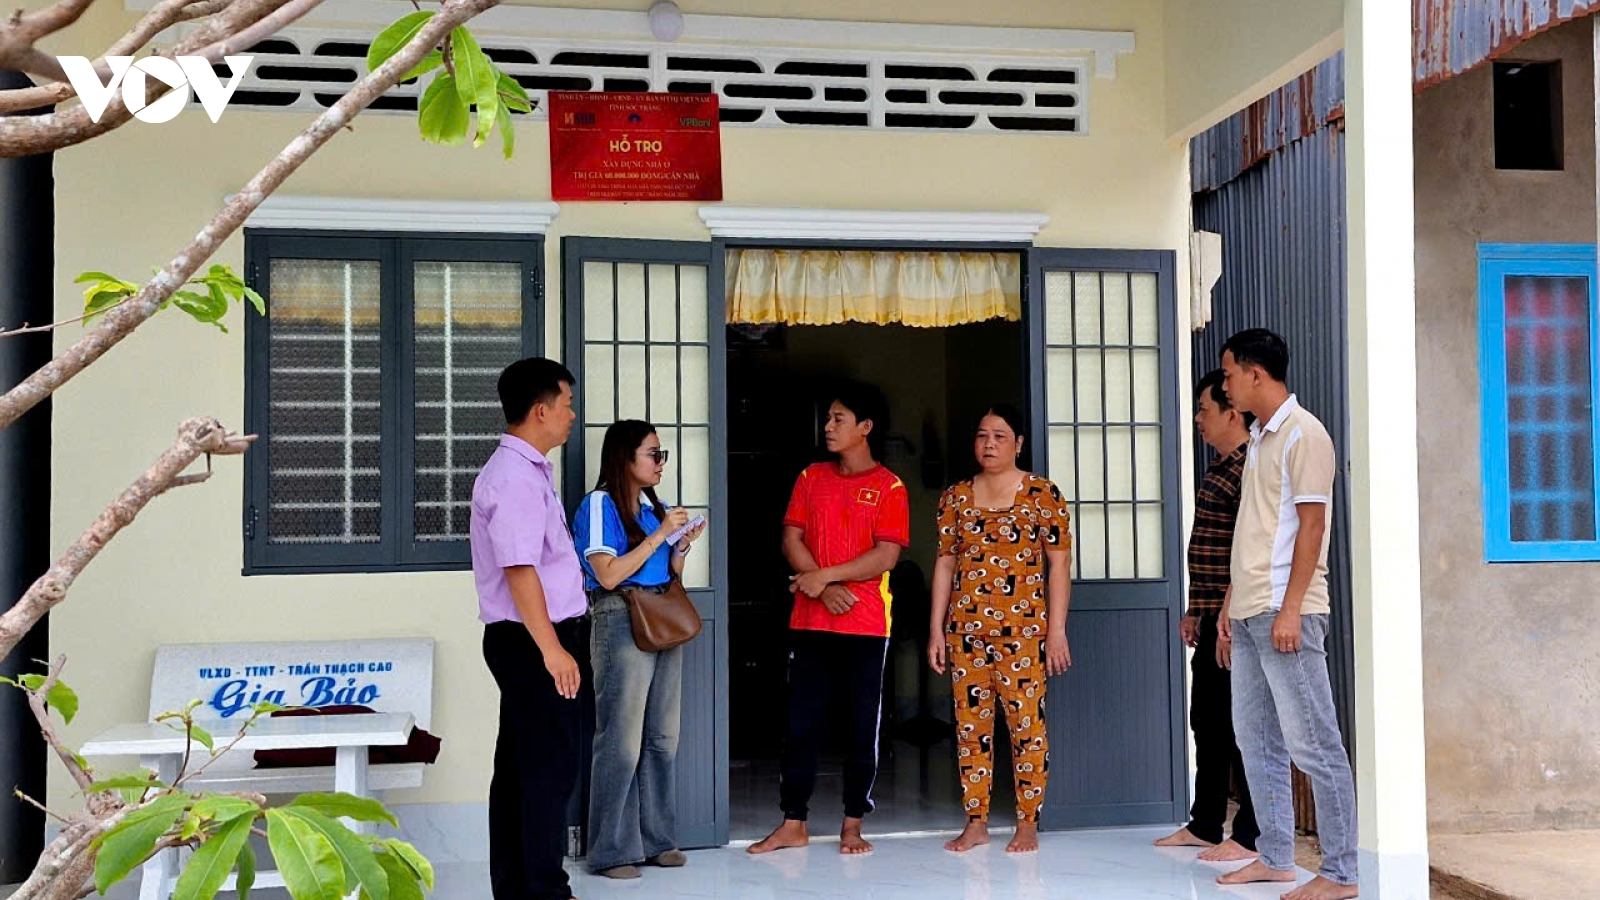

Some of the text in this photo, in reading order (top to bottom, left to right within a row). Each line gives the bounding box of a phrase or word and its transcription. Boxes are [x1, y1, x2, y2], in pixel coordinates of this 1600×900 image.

[634, 139, 663, 156] TRỢ
[200, 668, 231, 679] VLXD
[245, 665, 276, 677] TTNT
[325, 663, 365, 676] THẠCH
[368, 662, 392, 672] CAO
[207, 676, 381, 718] Gia Bảo
